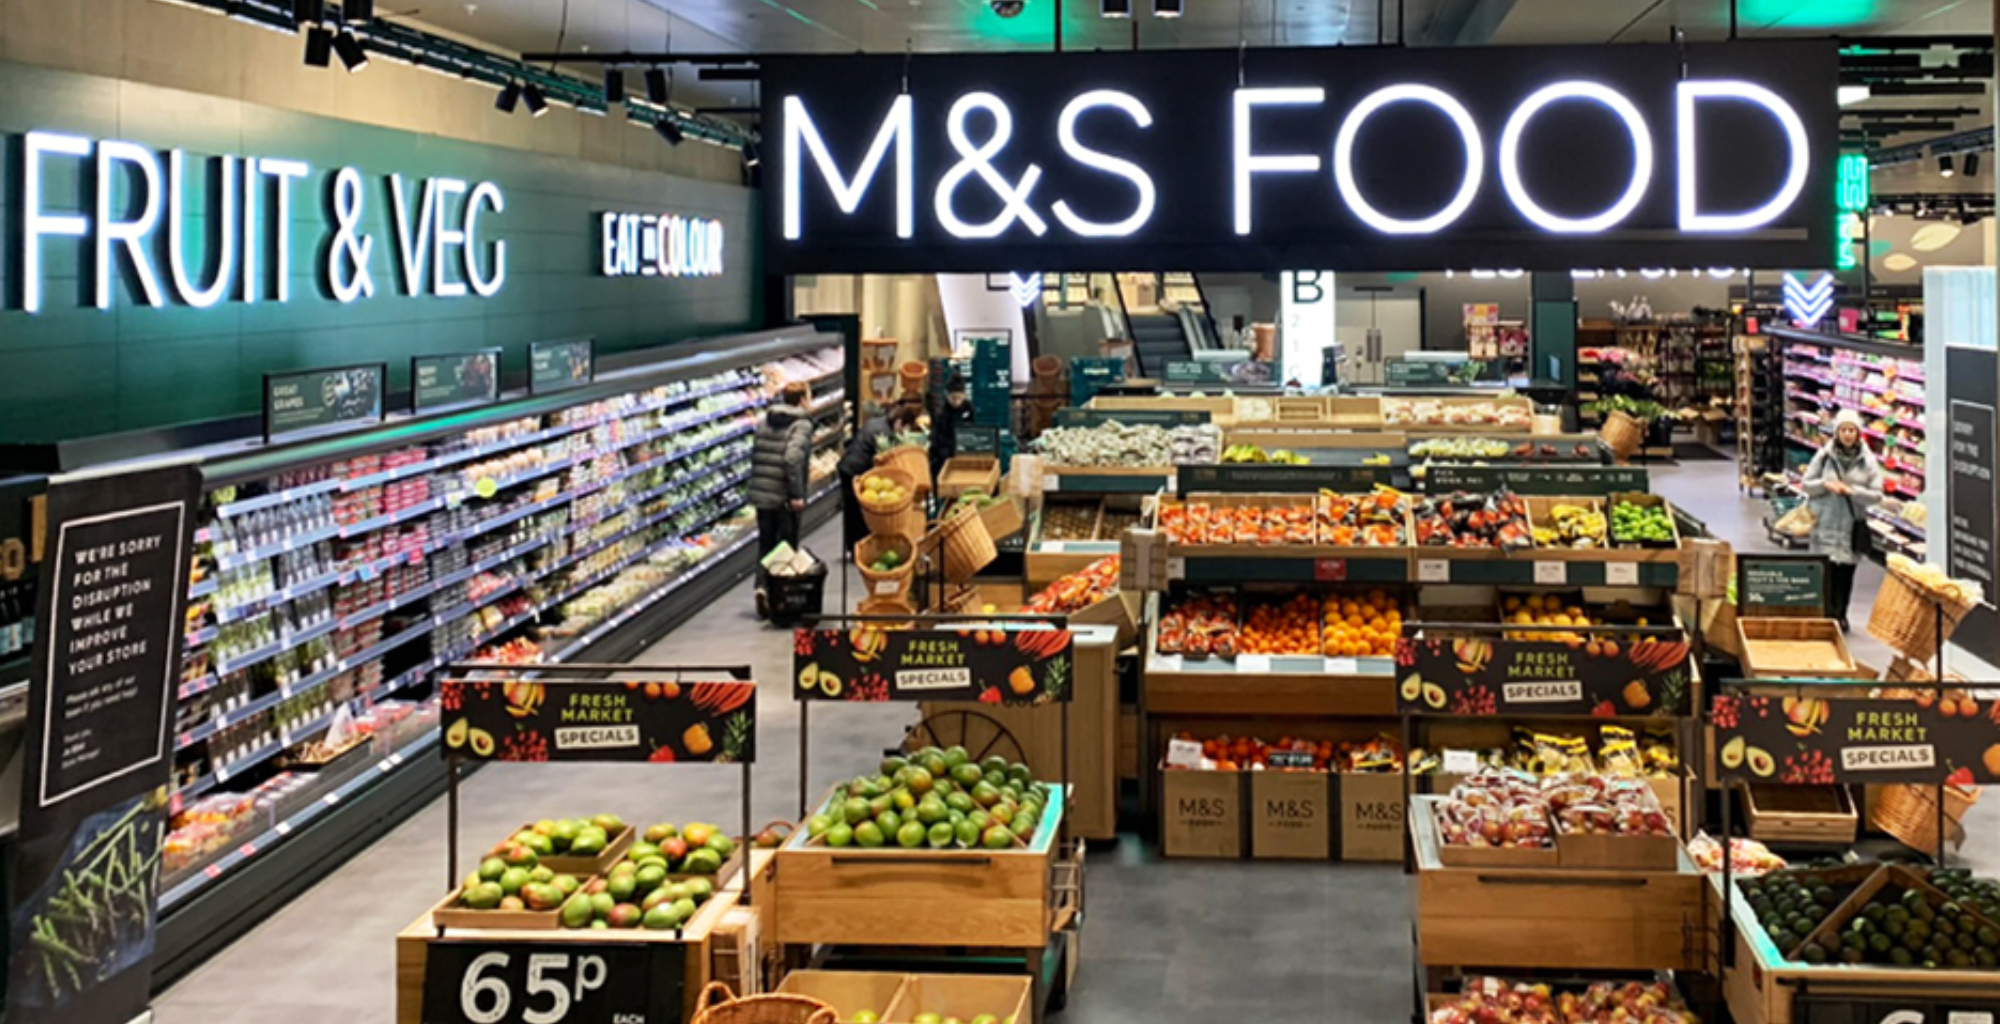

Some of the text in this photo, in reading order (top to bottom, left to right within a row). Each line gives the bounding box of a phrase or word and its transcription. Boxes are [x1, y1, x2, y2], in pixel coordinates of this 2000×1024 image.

[782, 80, 1811, 241] M&S FOOD
[23, 131, 506, 313] FRUIT & VEG
[603, 212, 640, 275] EAT
[658, 213, 723, 276] COLOUR
[1293, 270, 1324, 304] B
[75, 535, 162, 565] WE'RE SORRY
[73, 562, 129, 587] FOR THE
[72, 578, 152, 610] DISRUPTION
[71, 603, 133, 631] WHILE WE
[69, 625, 127, 654] IMPROVE
[907, 640, 959, 653] FRESH
[68, 641, 147, 675] YOUR STORE
[901, 653, 966, 666] MARKET
[1516, 652, 1569, 664] FRESH
[900, 671, 967, 685] SPECIALS
[1508, 665, 1576, 677] MARKET
[569, 693, 627, 707] FRESH
[1507, 684, 1578, 698] SPECIALS
[561, 708, 634, 721] MARKET
[1856, 711, 1918, 726] FRESH
[559, 729, 635, 745] SPECIALS
[1847, 727, 1927, 741] MARKET
[1846, 748, 1930, 766] SPECIALS
[1179, 798, 1225, 818] M&S
[1267, 801, 1314, 819] M&S
[1356, 802, 1403, 821] M&S
[459, 951, 607, 1024] 65p
[613, 1013, 644, 1024] EACH
